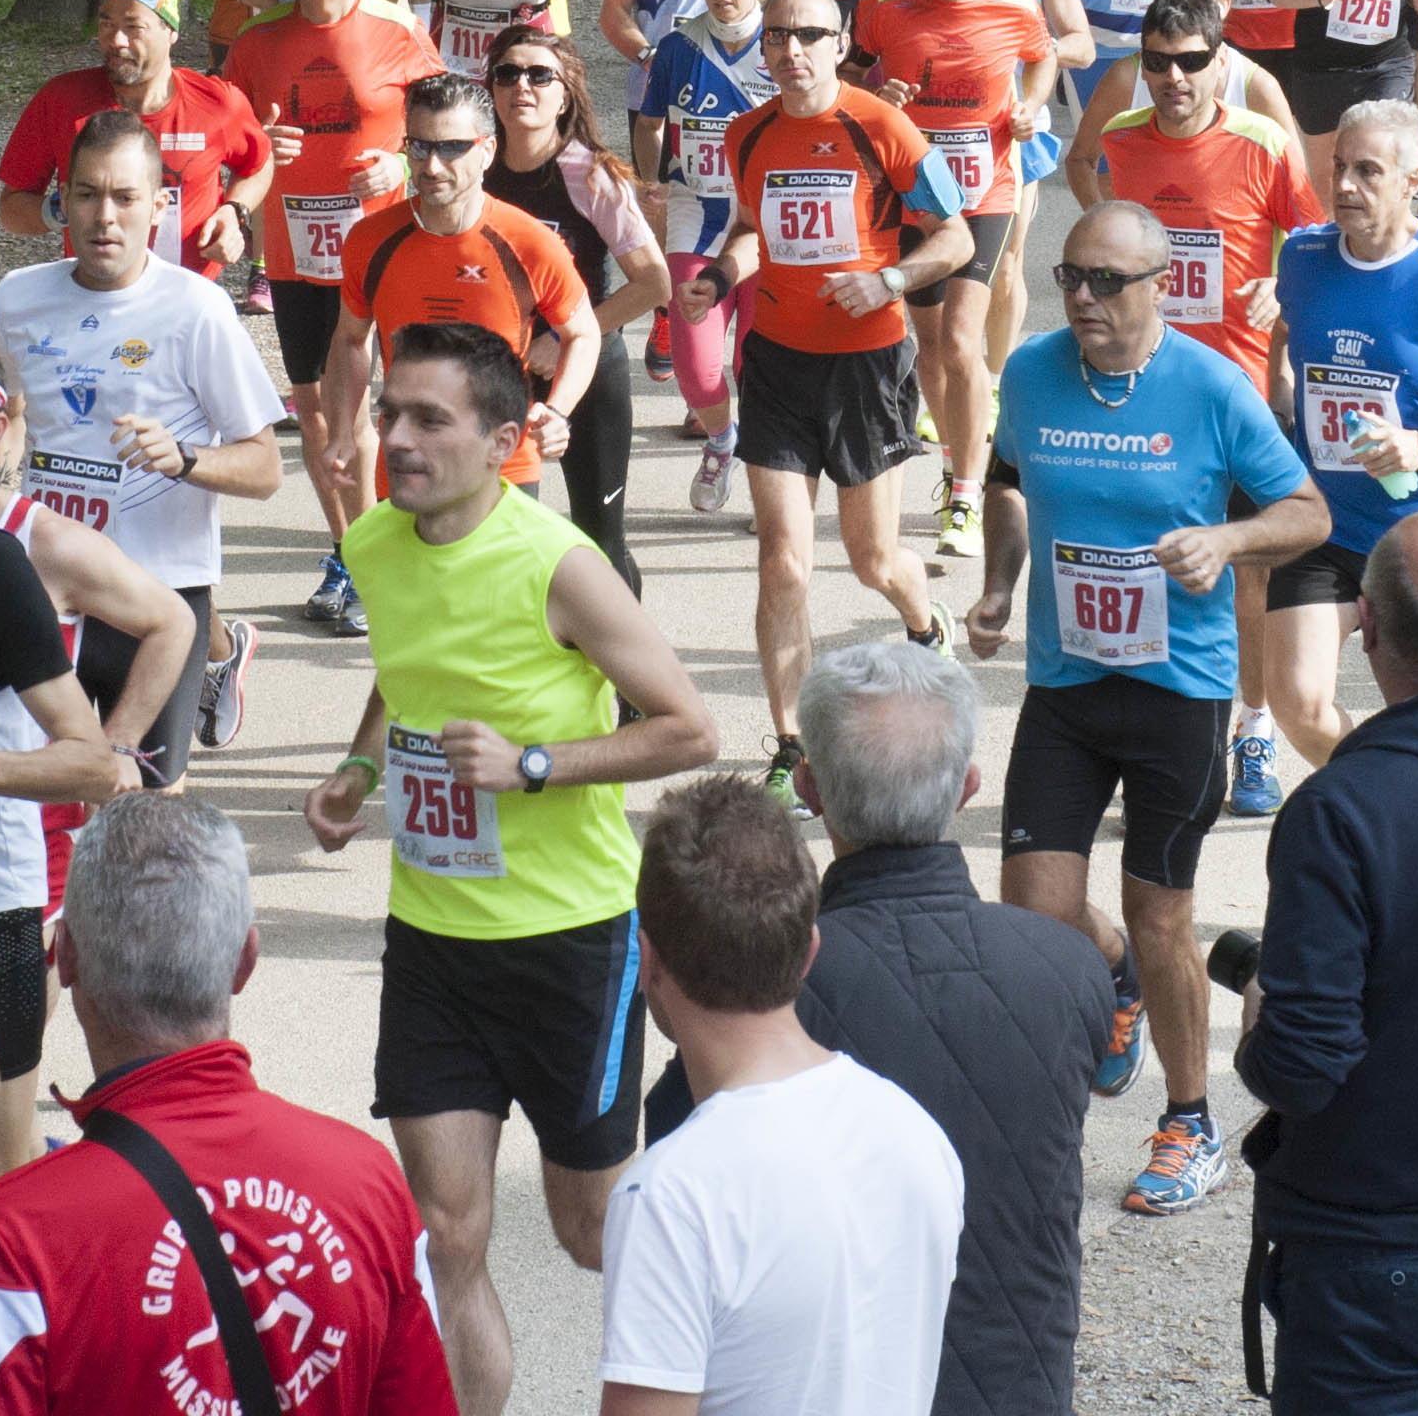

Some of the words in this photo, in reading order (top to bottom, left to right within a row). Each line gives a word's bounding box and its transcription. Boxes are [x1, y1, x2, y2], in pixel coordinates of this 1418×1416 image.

[934, 133, 987, 143] DIADORA
[686, 152, 693, 174] F
[788, 175, 850, 186] DIADORA
[302, 197, 358, 210] DIADORA
[780, 200, 835, 241] 521
[1186, 306, 1219, 316] CRC
[1327, 329, 1376, 346] PODISTICA
[1335, 337, 1362, 357] GAU
[1332, 355, 1367, 368] GENOVA
[1328, 371, 1391, 389] DIADORA
[50, 457, 118, 480] DIADORA
[1074, 457, 1096, 469] GPS
[1098, 459, 1118, 470] PER
[1121, 460, 1139, 471] LO
[1140, 460, 1178, 473] SPORT
[1081, 550, 1158, 568] DIADORA
[1074, 583, 1144, 634] 687
[1124, 640, 1164, 655] CRC
[403, 774, 478, 841] 259
[453, 851, 499, 868] CRC
[141, 1185, 216, 1317] GRUP
[223, 1176, 353, 1285] PODISTICO
[274, 1324, 348, 1412] ZZILE
